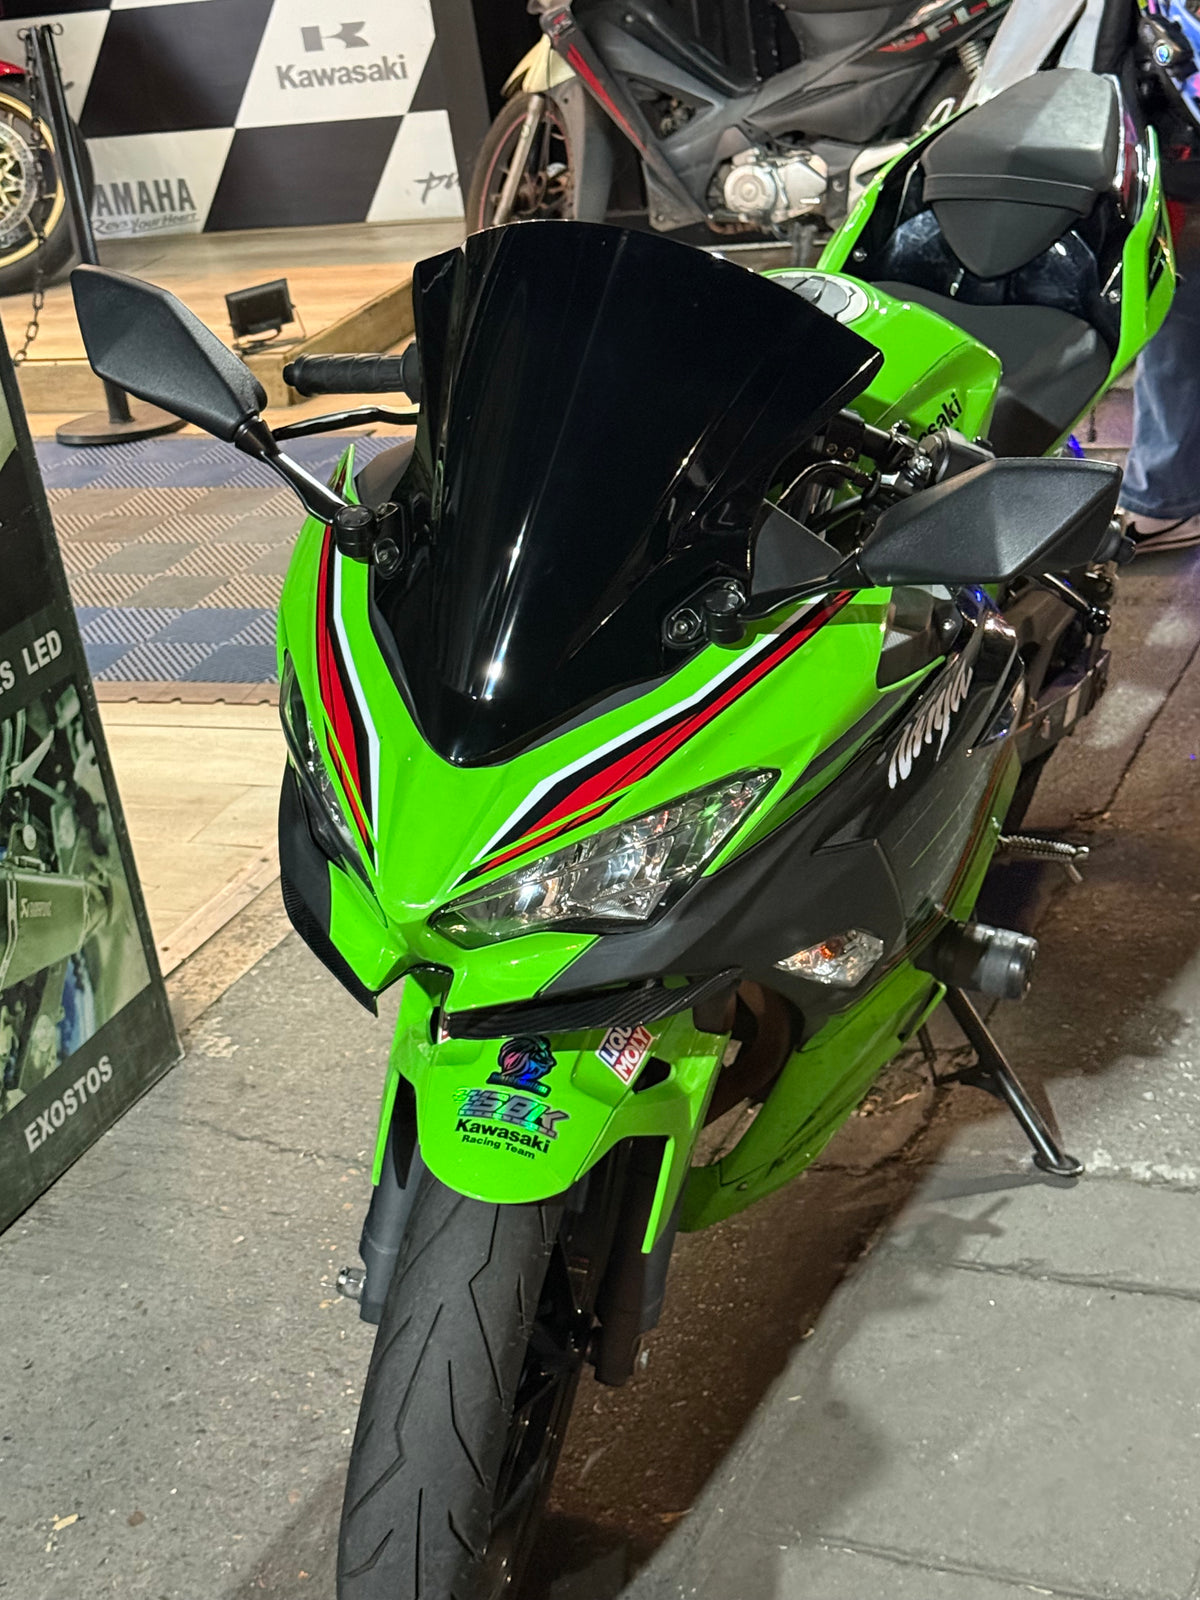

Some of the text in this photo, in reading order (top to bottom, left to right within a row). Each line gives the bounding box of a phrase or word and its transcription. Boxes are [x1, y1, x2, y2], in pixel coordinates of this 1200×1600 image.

[275, 53, 409, 91] Kawasaki
[94, 178, 197, 216] AMAHA
[0, 629, 63, 695] S LED
[600, 1026, 632, 1066] LIQU
[614, 1025, 649, 1080] MOLY
[23, 1054, 113, 1155] EXOSTOS
[456, 1088, 571, 1135] SBK
[454, 1118, 551, 1154] Kawasaki
[461, 1134, 536, 1160] Racing Team
